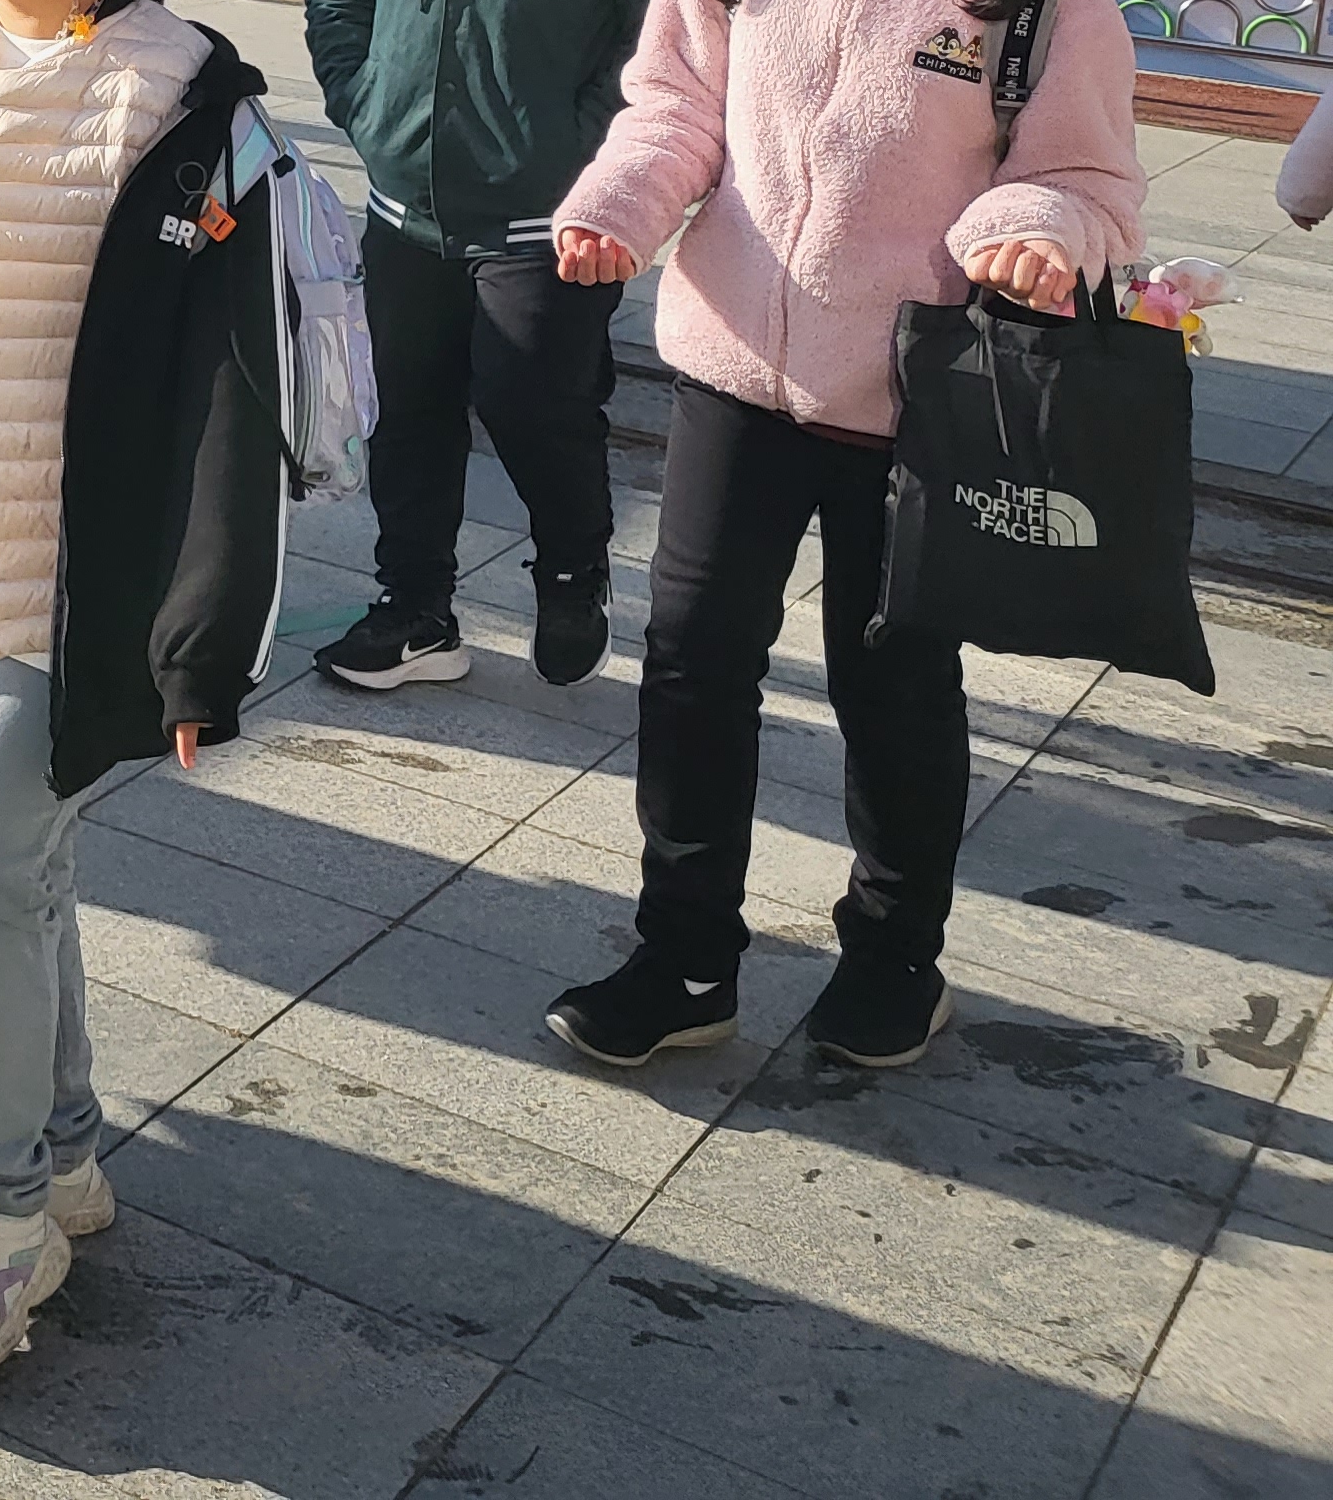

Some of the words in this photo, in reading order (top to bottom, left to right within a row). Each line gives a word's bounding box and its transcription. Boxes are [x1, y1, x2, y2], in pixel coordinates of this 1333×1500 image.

[158, 214, 197, 249] BR
[954, 483, 1045, 527] NORTH
[995, 478, 1046, 508] THE
[980, 512, 1046, 546] FACE
